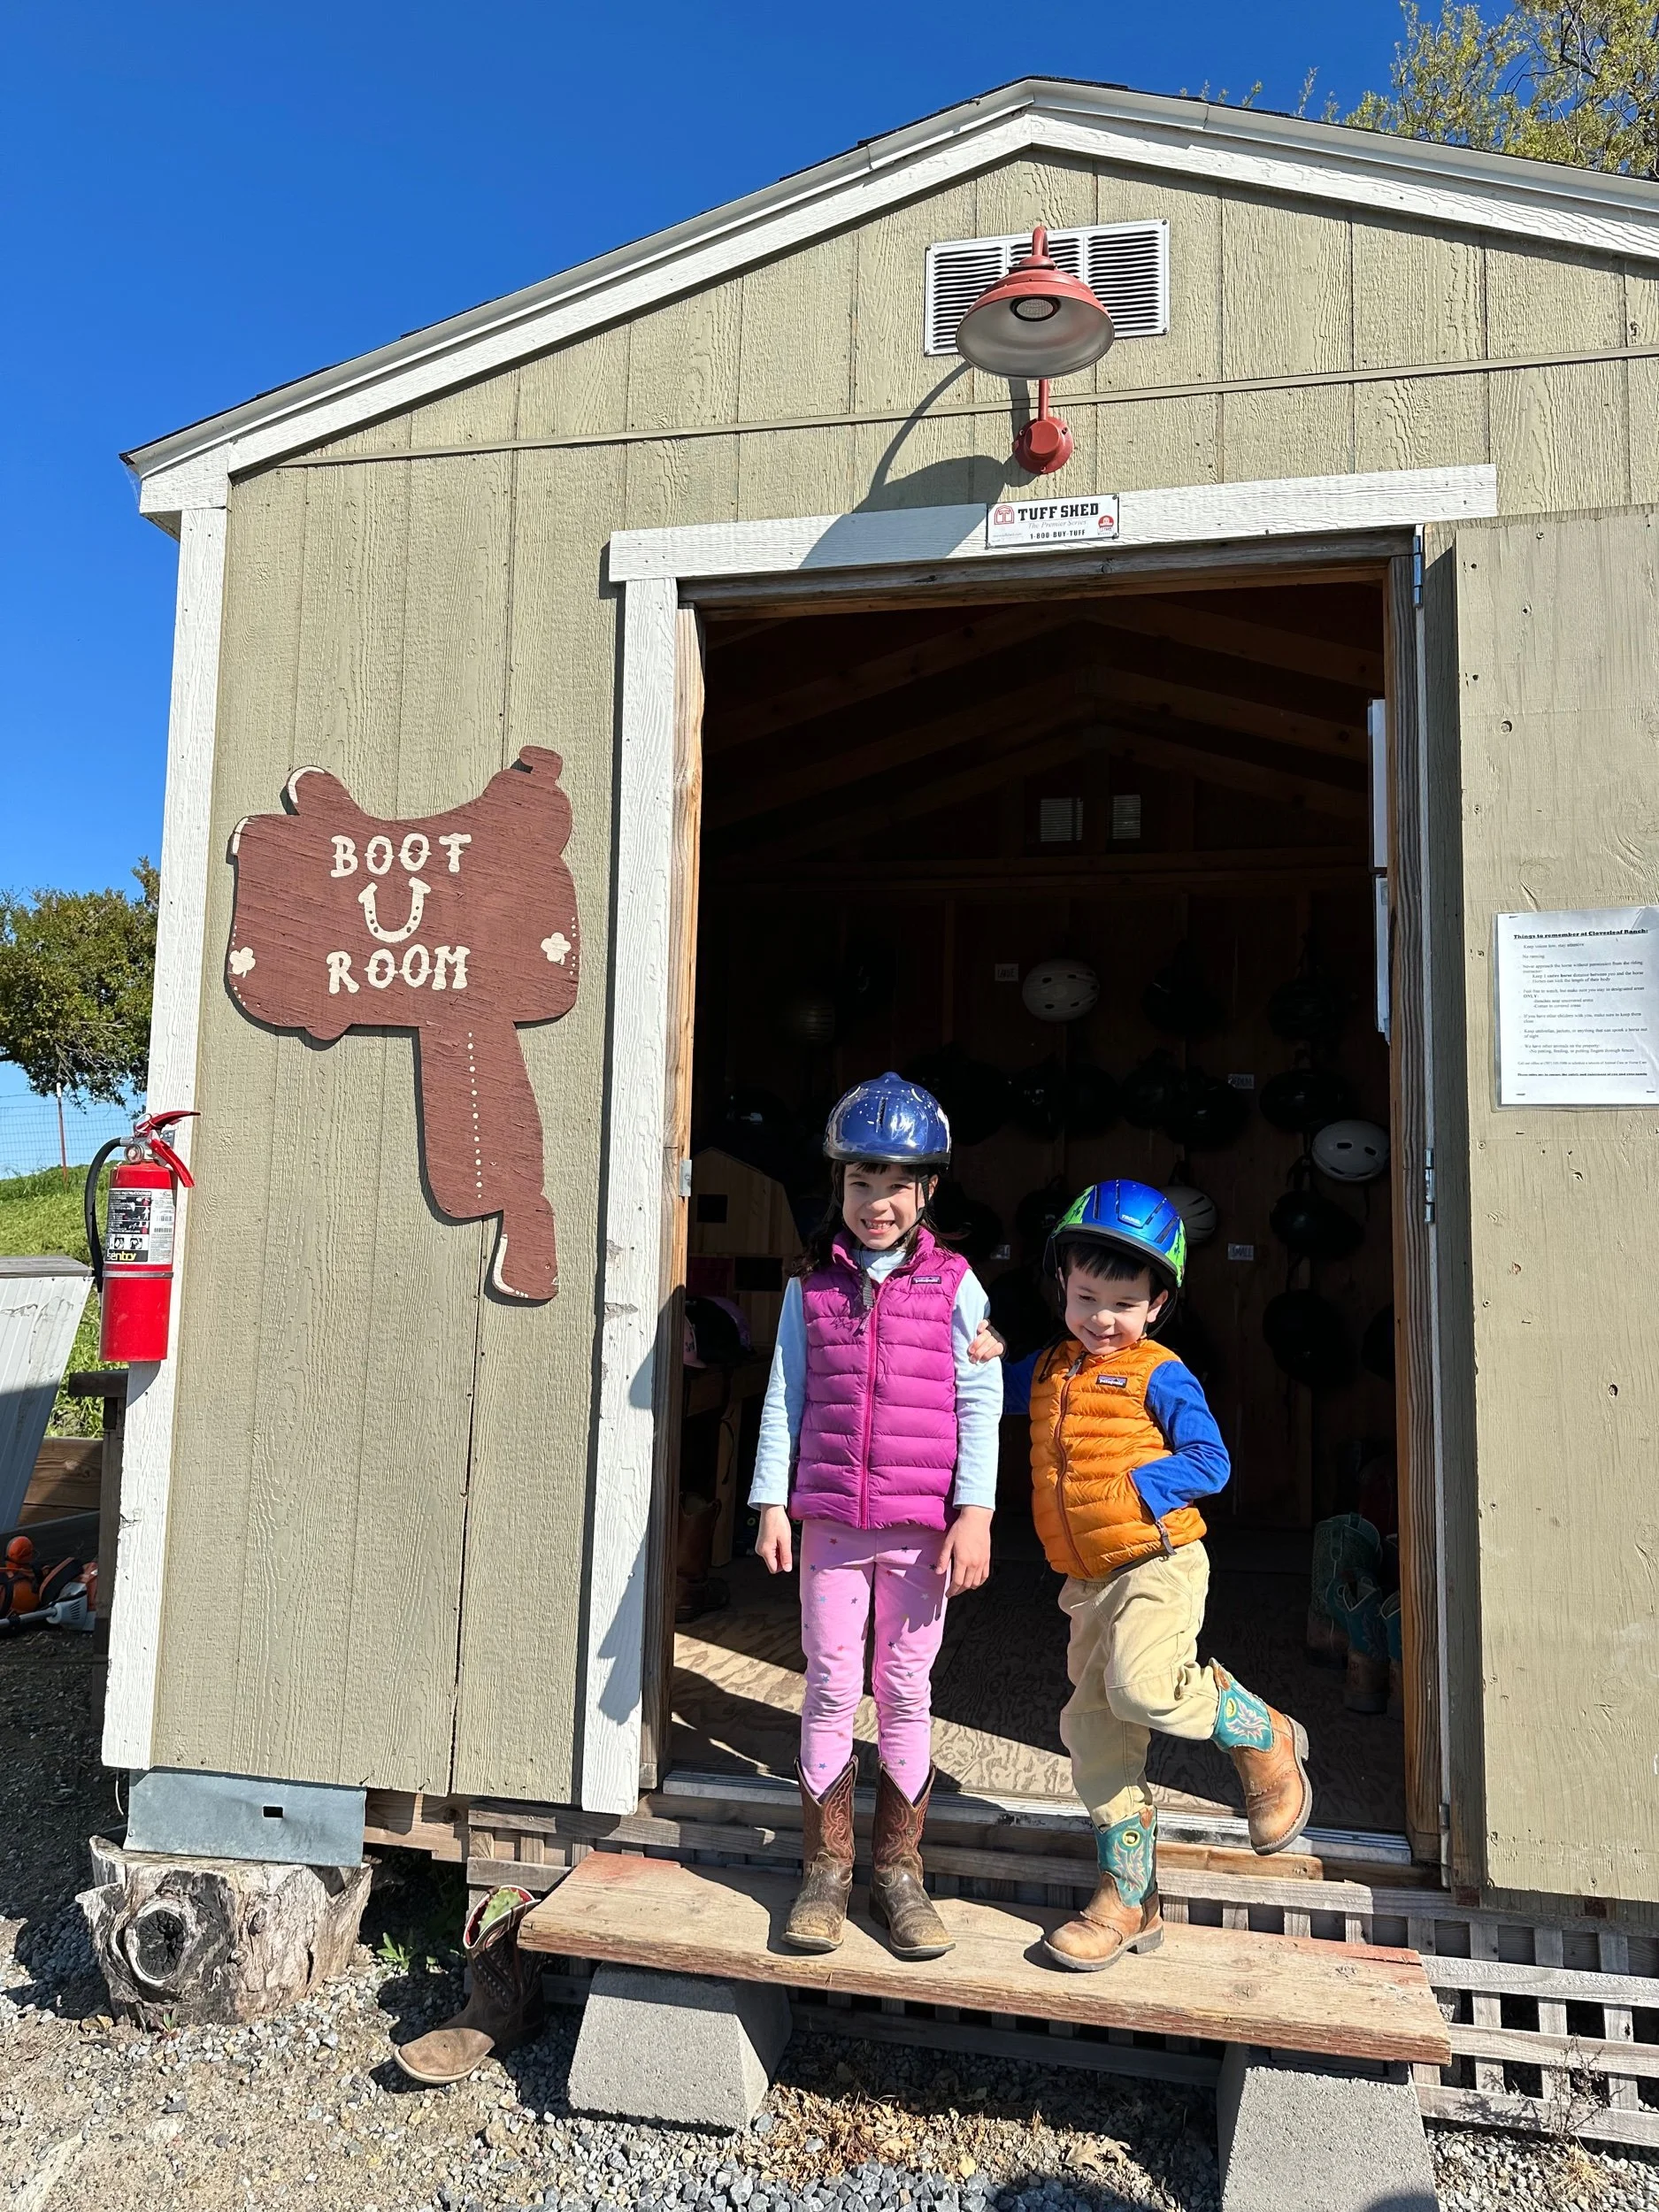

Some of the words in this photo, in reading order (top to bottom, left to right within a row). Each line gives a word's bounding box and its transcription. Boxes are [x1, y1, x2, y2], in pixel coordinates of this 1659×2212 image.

[1018, 506, 1058, 521] TUFF
[1060, 502, 1099, 518] SHED
[1041, 519, 1067, 529] Premier
[330, 832, 472, 878] BOOT
[326, 943, 472, 995] ROOM
